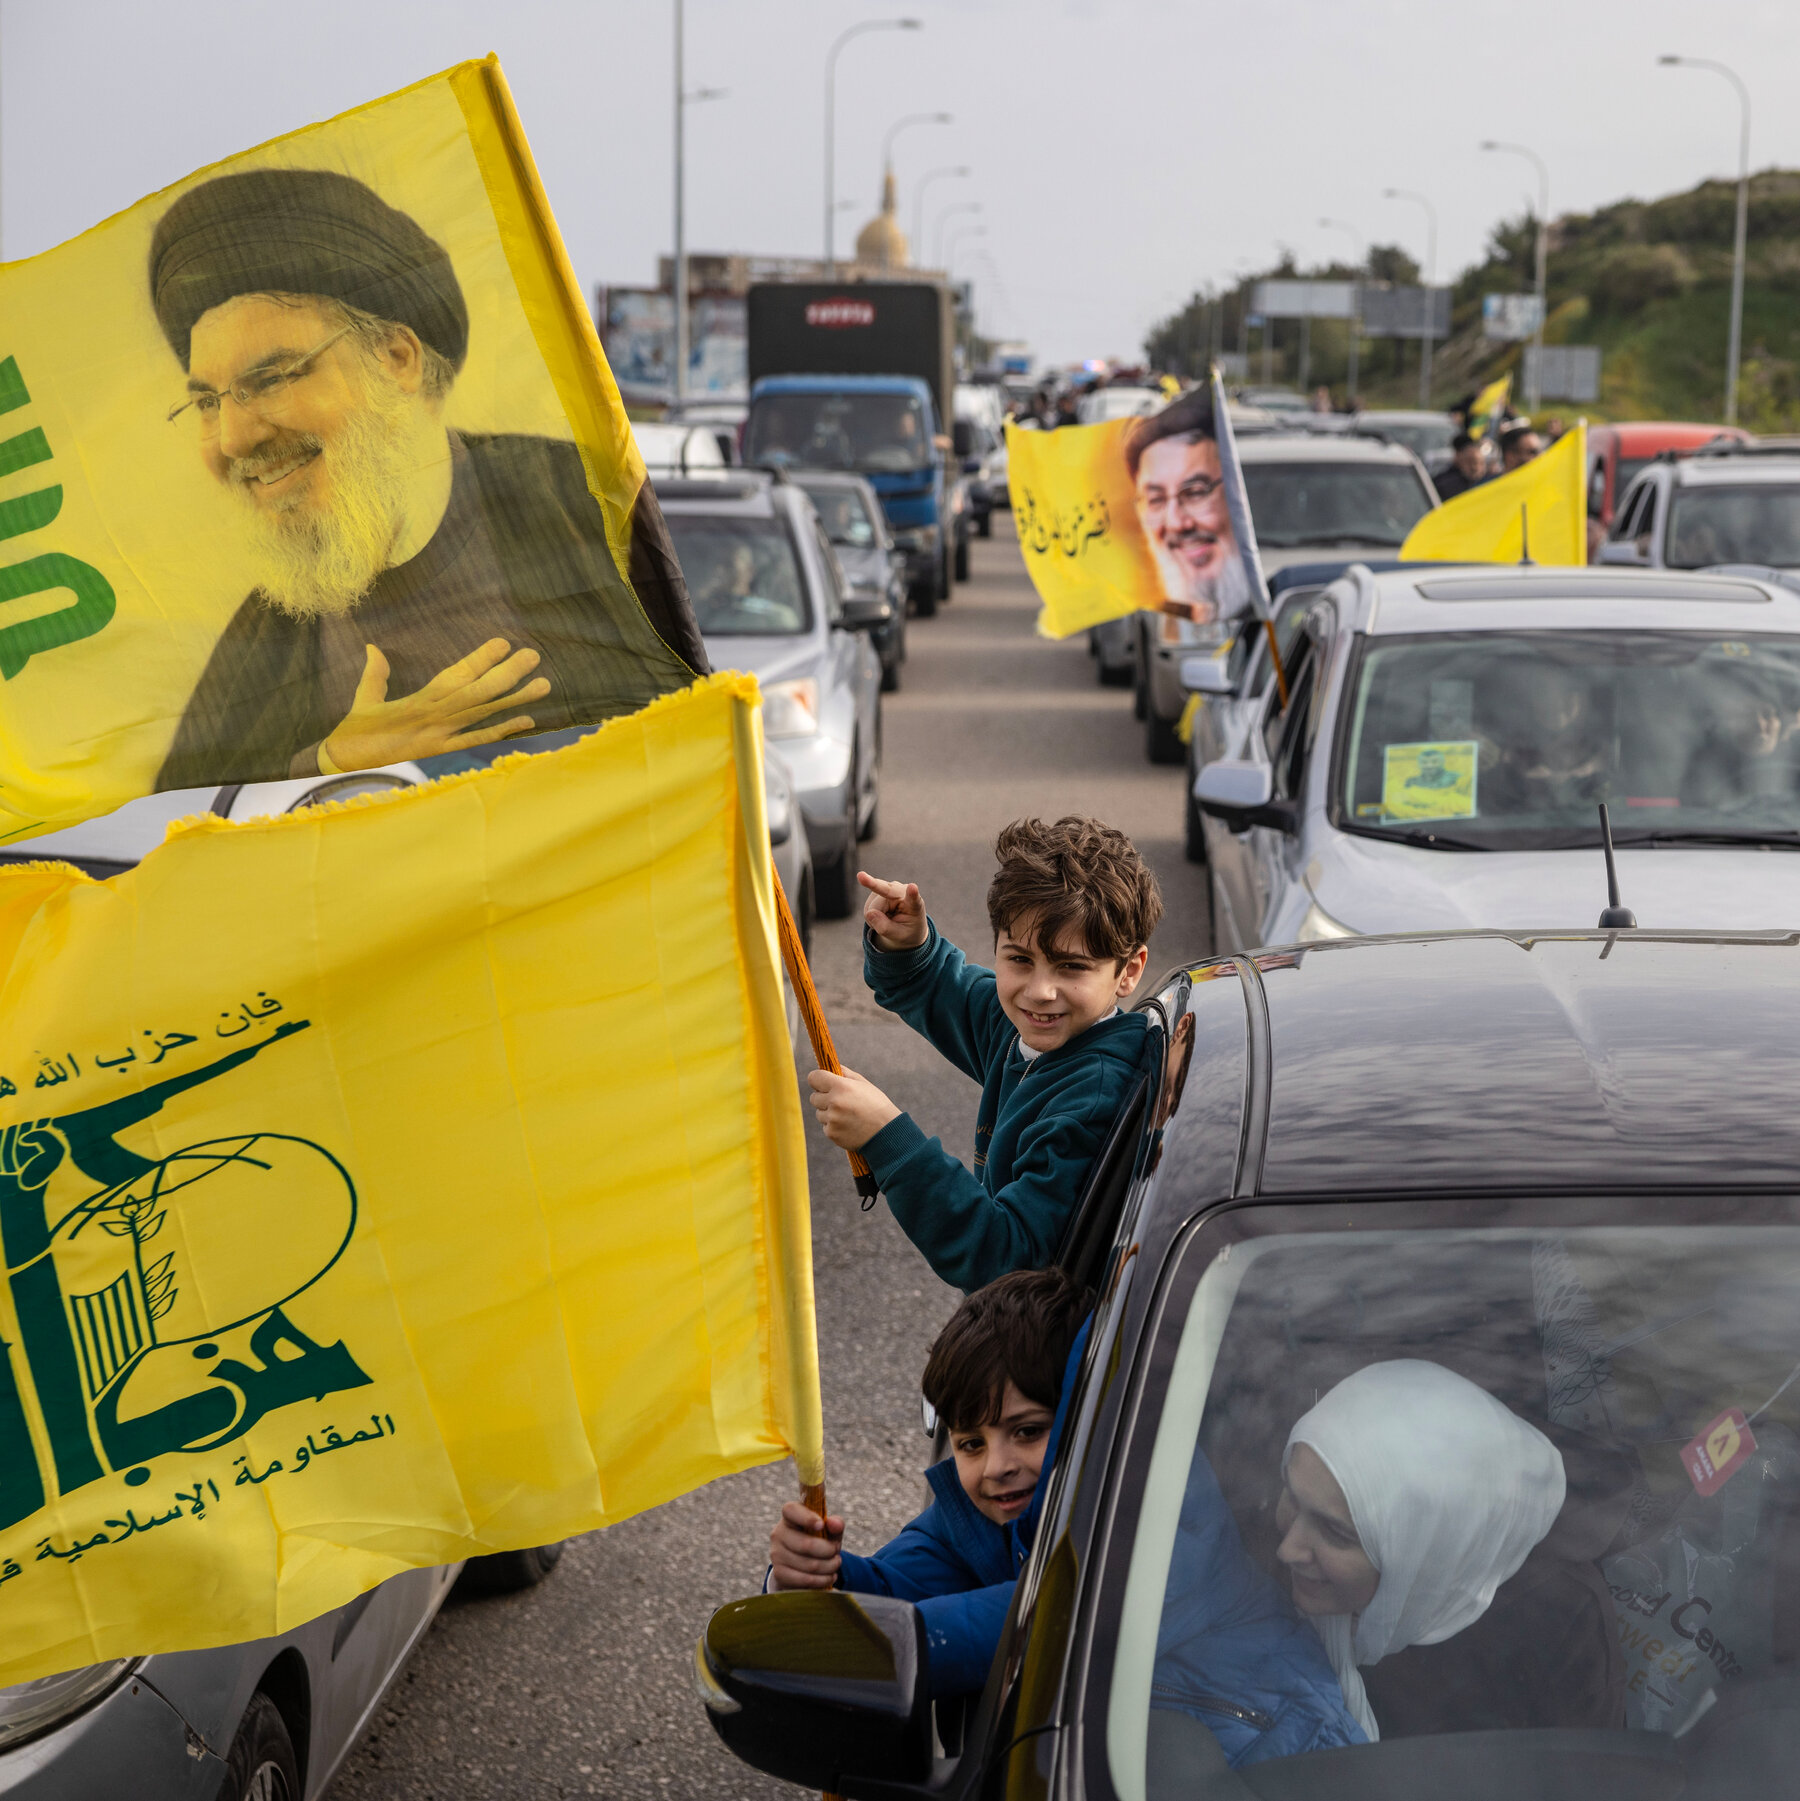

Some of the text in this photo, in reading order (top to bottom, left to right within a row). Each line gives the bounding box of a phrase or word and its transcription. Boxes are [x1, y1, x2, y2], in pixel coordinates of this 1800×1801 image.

[95, 1029, 198, 1074] حزب
[235, 1414, 396, 1487] المقاومة
[35, 1478, 220, 1564] الإسلامية
